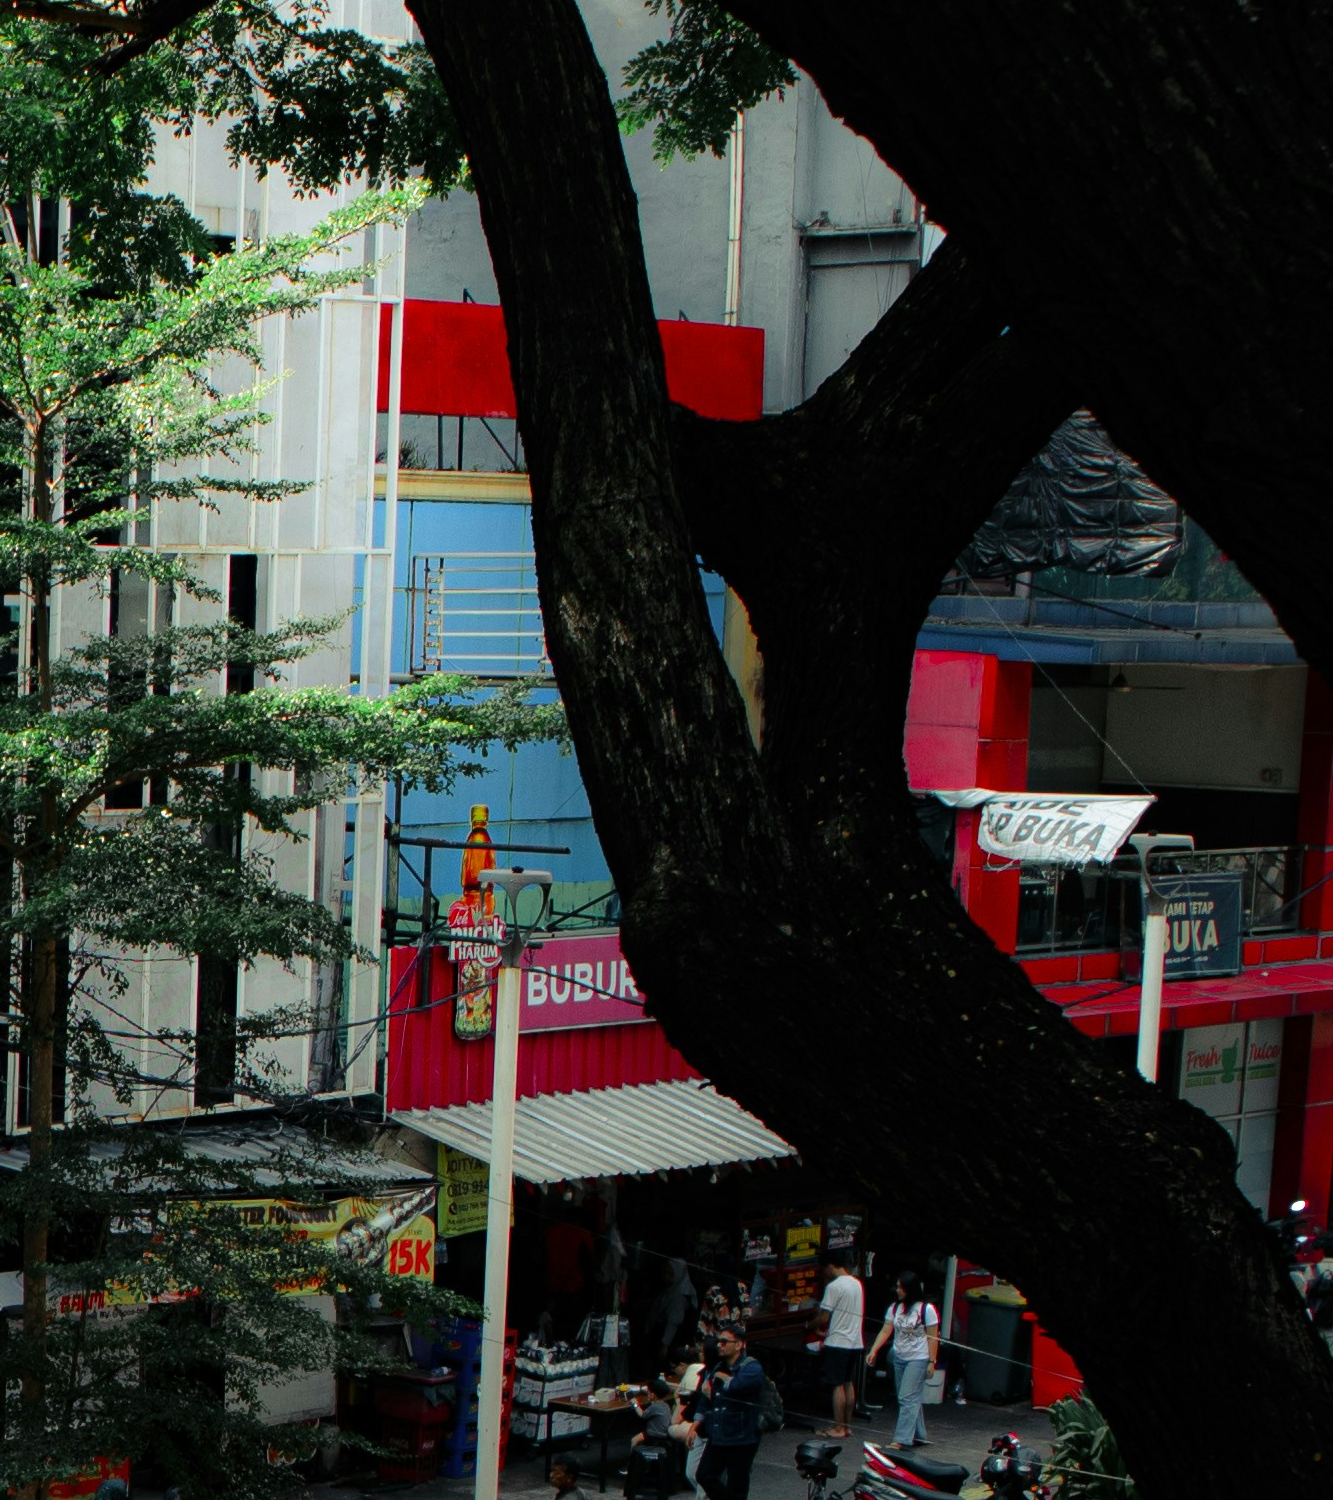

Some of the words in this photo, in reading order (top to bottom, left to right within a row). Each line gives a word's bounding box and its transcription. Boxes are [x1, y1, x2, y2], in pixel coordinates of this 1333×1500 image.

[1013, 815, 1106, 852] BUKA
[458, 944, 498, 960] HARUM
[528, 960, 638, 1007] BUBUR
[1186, 1047, 1220, 1071] Fresh
[389, 1239, 432, 1275] 15K
